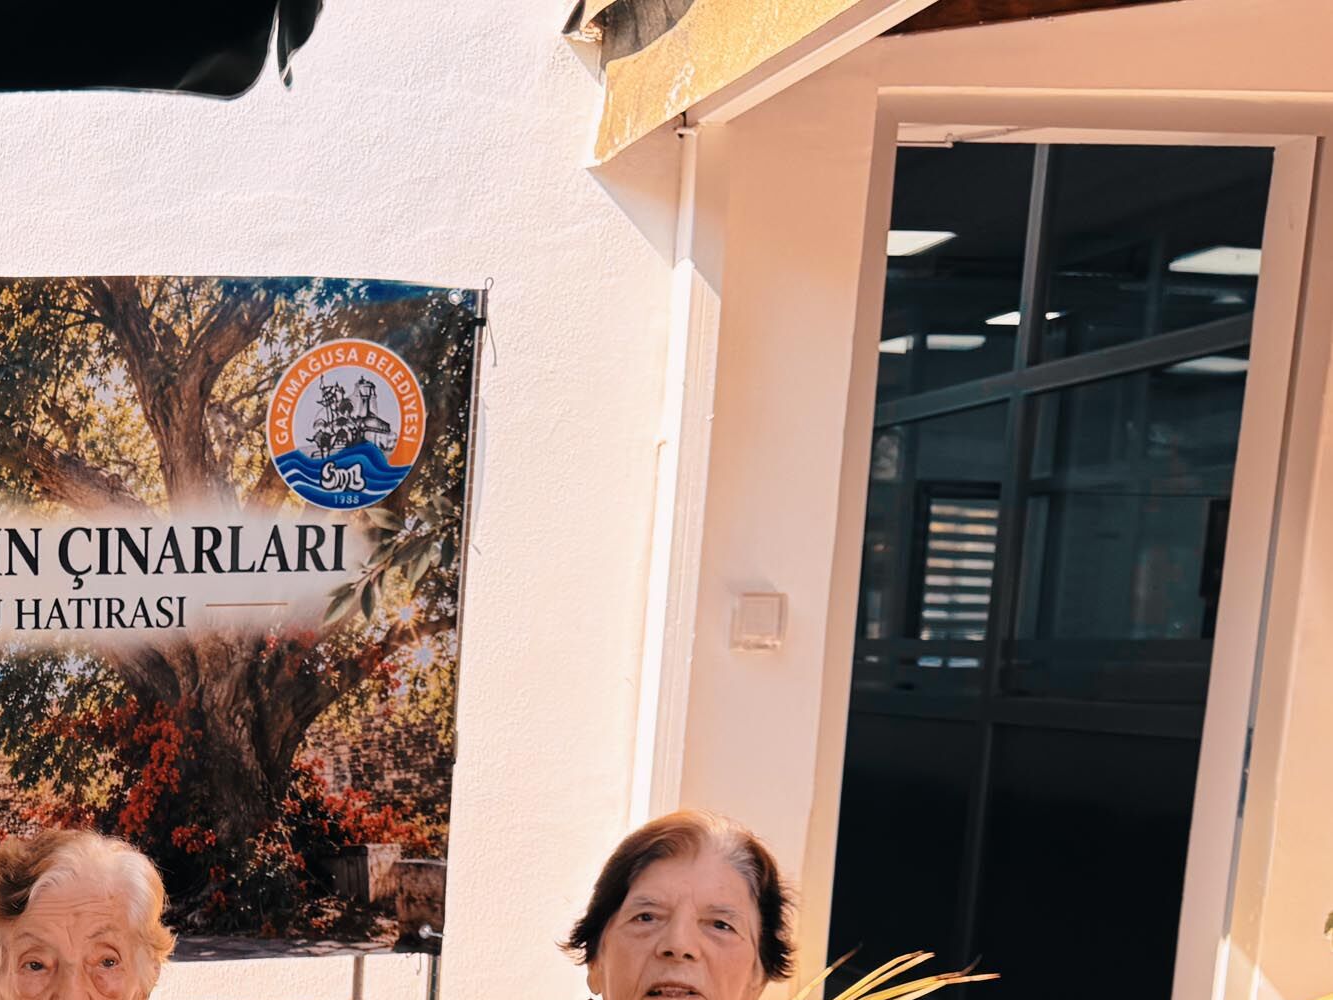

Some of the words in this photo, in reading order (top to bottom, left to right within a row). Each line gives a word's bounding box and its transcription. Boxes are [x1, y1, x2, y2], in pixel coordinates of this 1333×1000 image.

[275, 347, 359, 445] GAZİMAĞUSA
[58, 523, 348, 590] ÇINARLARI
[15, 596, 187, 631] HATIRASI
